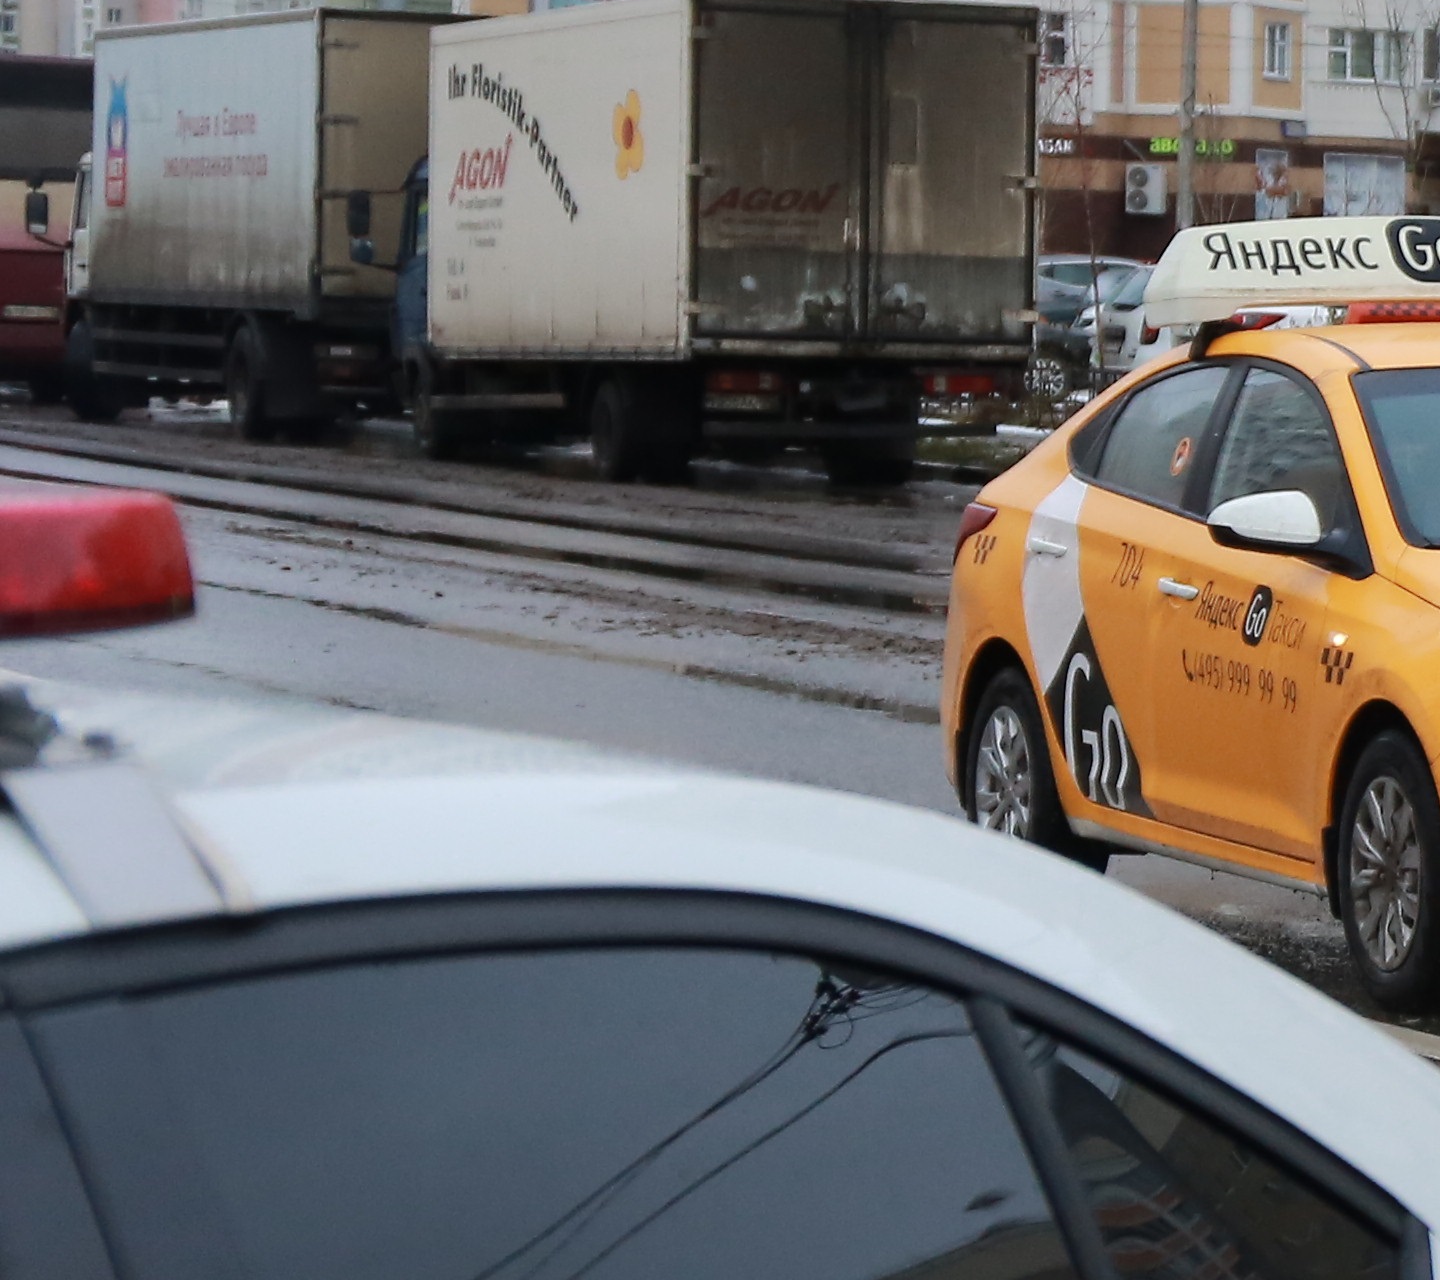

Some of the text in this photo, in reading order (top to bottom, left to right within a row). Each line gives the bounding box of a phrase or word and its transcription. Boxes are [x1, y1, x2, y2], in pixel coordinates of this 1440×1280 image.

[448, 63, 578, 223] Ihr Floristik-Partner
[448, 131, 513, 206] AGON
[703, 181, 840, 218] AGON
[1202, 232, 1379, 276] Яндекс
[1111, 542, 1145, 590] 704
[1195, 580, 1307, 650] Яндекс Go Такси
[1192, 650, 1297, 714] (495) 999 99 99
[1064, 652, 1128, 810] Go
